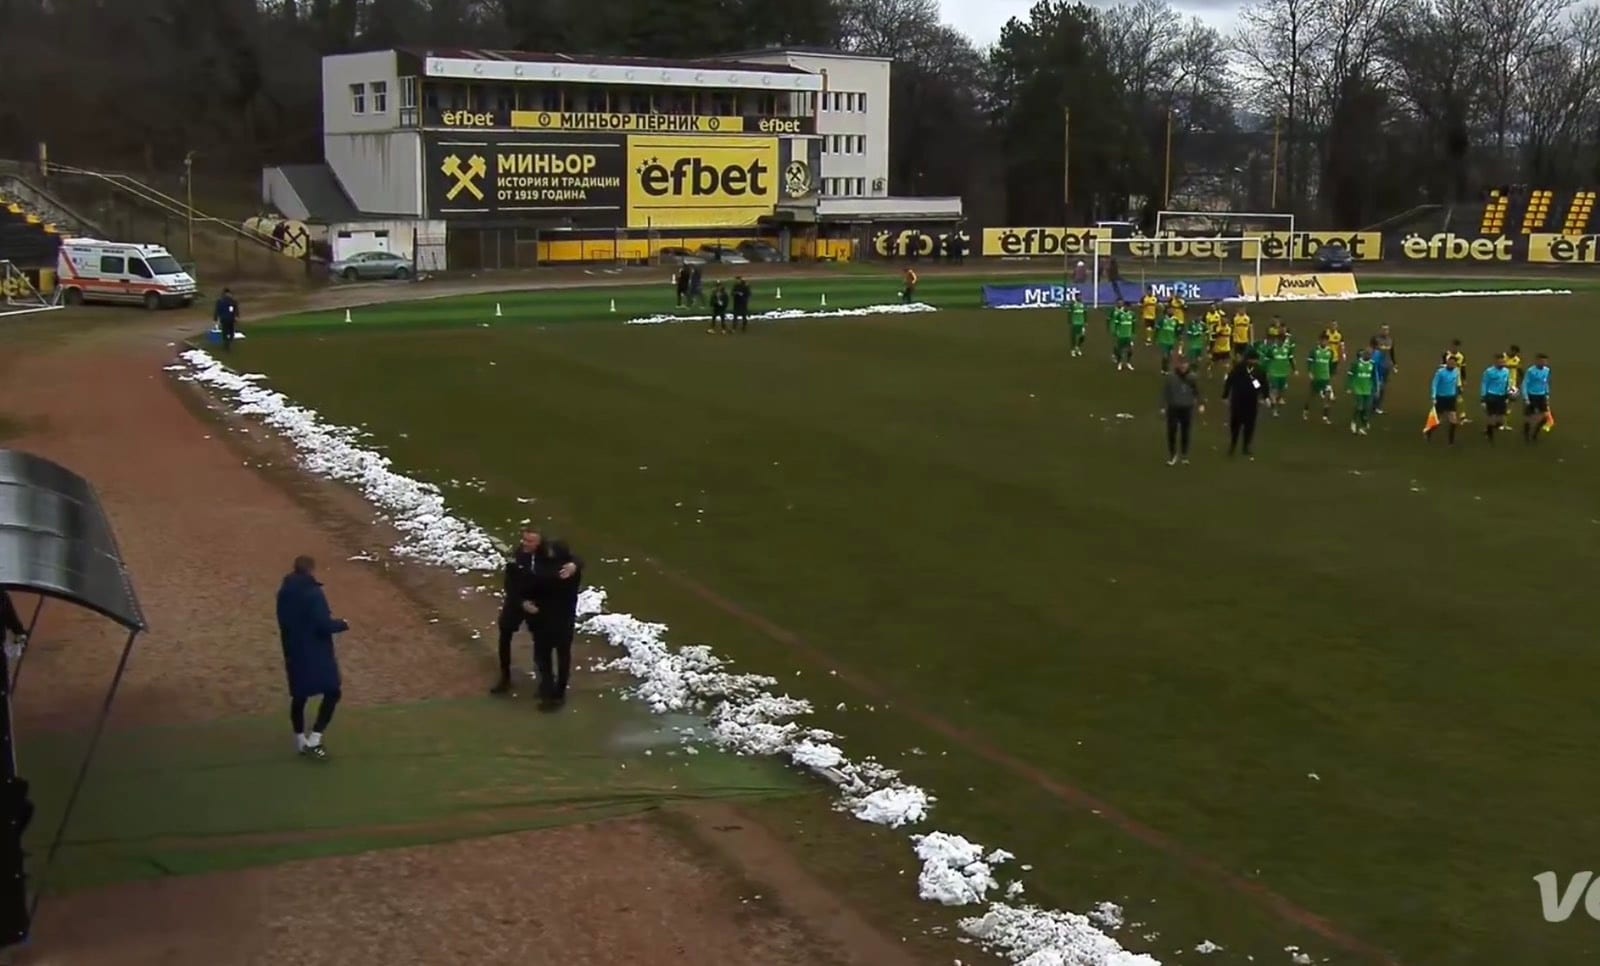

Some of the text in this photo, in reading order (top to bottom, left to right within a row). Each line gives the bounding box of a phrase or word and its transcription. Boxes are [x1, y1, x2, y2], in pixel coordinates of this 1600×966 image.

[442, 110, 494, 126] efbet
[560, 113, 699, 131] МИНЬОР ПЕРНИК
[759, 118, 800, 133] efbet
[497, 154, 597, 175] МИНЬОР
[497, 177, 620, 189] ИСТОРИЯ И ТРАДИЦИИ
[639, 157, 768, 197] efbet
[497, 190, 586, 201] ОТ 1919 ГОДИНА
[1000, 229, 1097, 254] efbet
[1402, 233, 1513, 261] efbet
[1025, 286, 1080, 303] MrBit
[1152, 281, 1200, 298] MrBit
